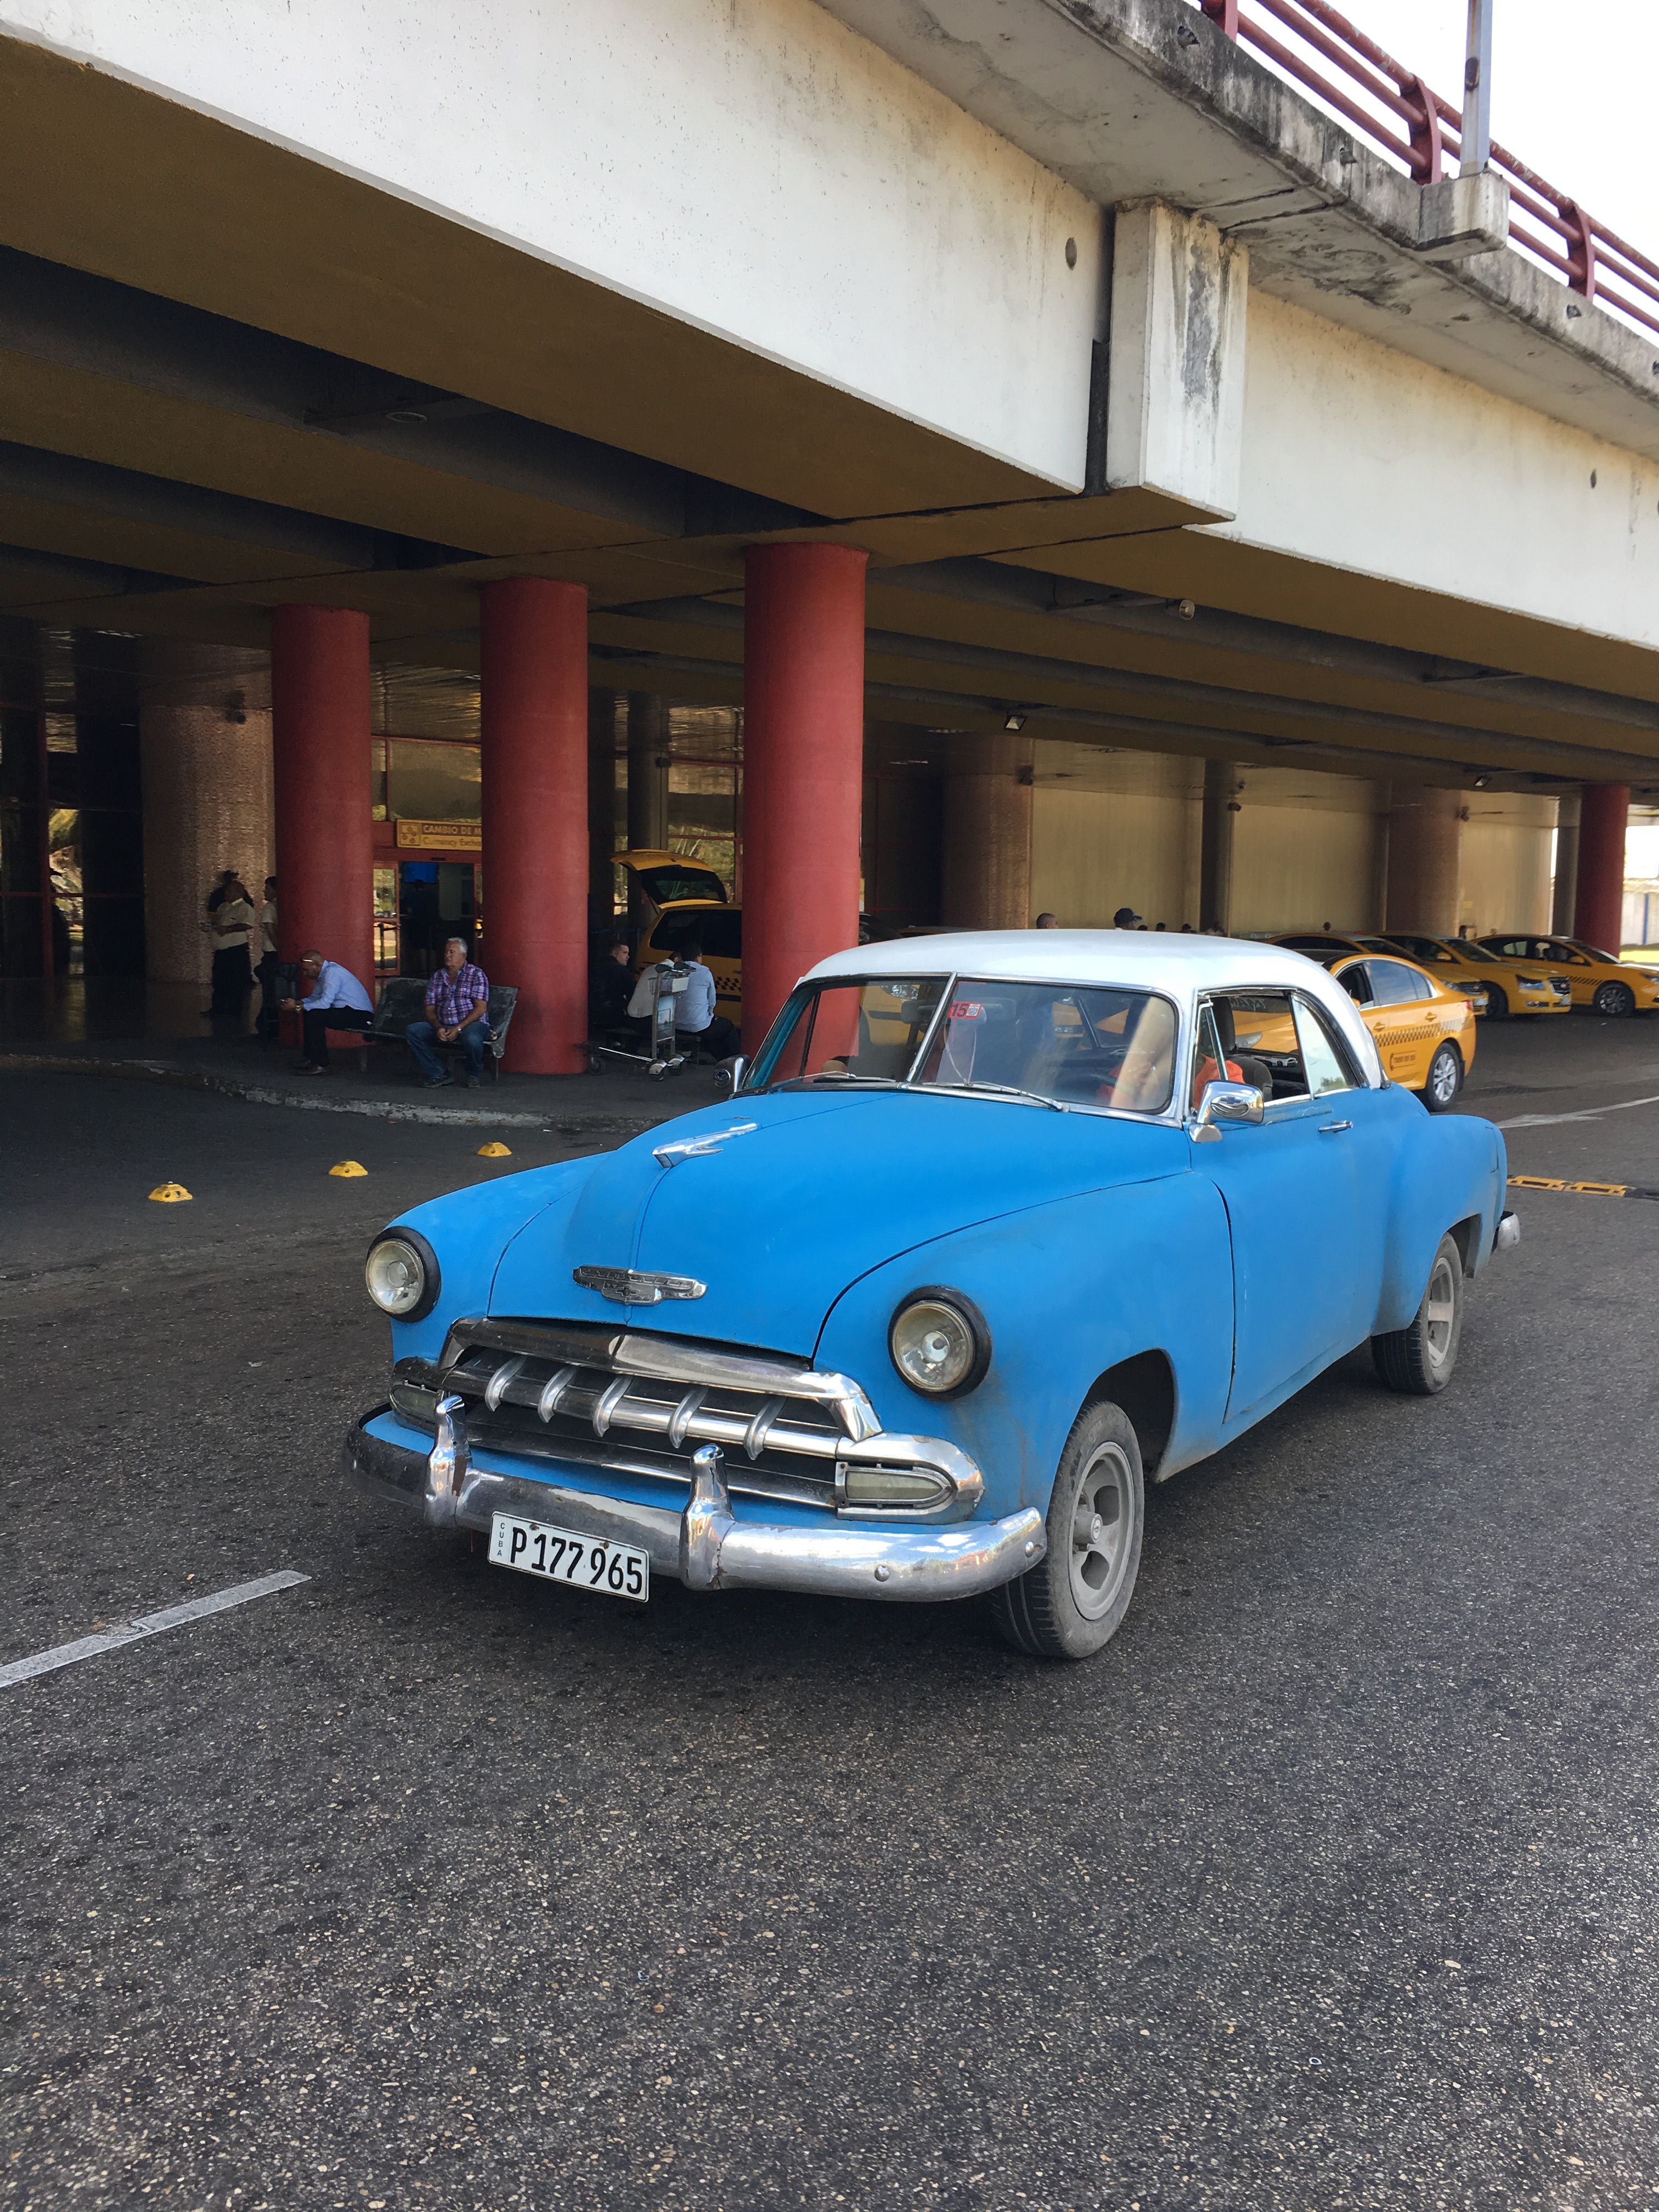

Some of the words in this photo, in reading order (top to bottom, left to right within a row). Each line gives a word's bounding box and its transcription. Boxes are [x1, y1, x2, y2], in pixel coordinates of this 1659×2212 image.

[424, 825, 458, 834] CAMBIO
[951, 1003, 968, 1017] 15
[497, 1522, 505, 1557] CUBA
